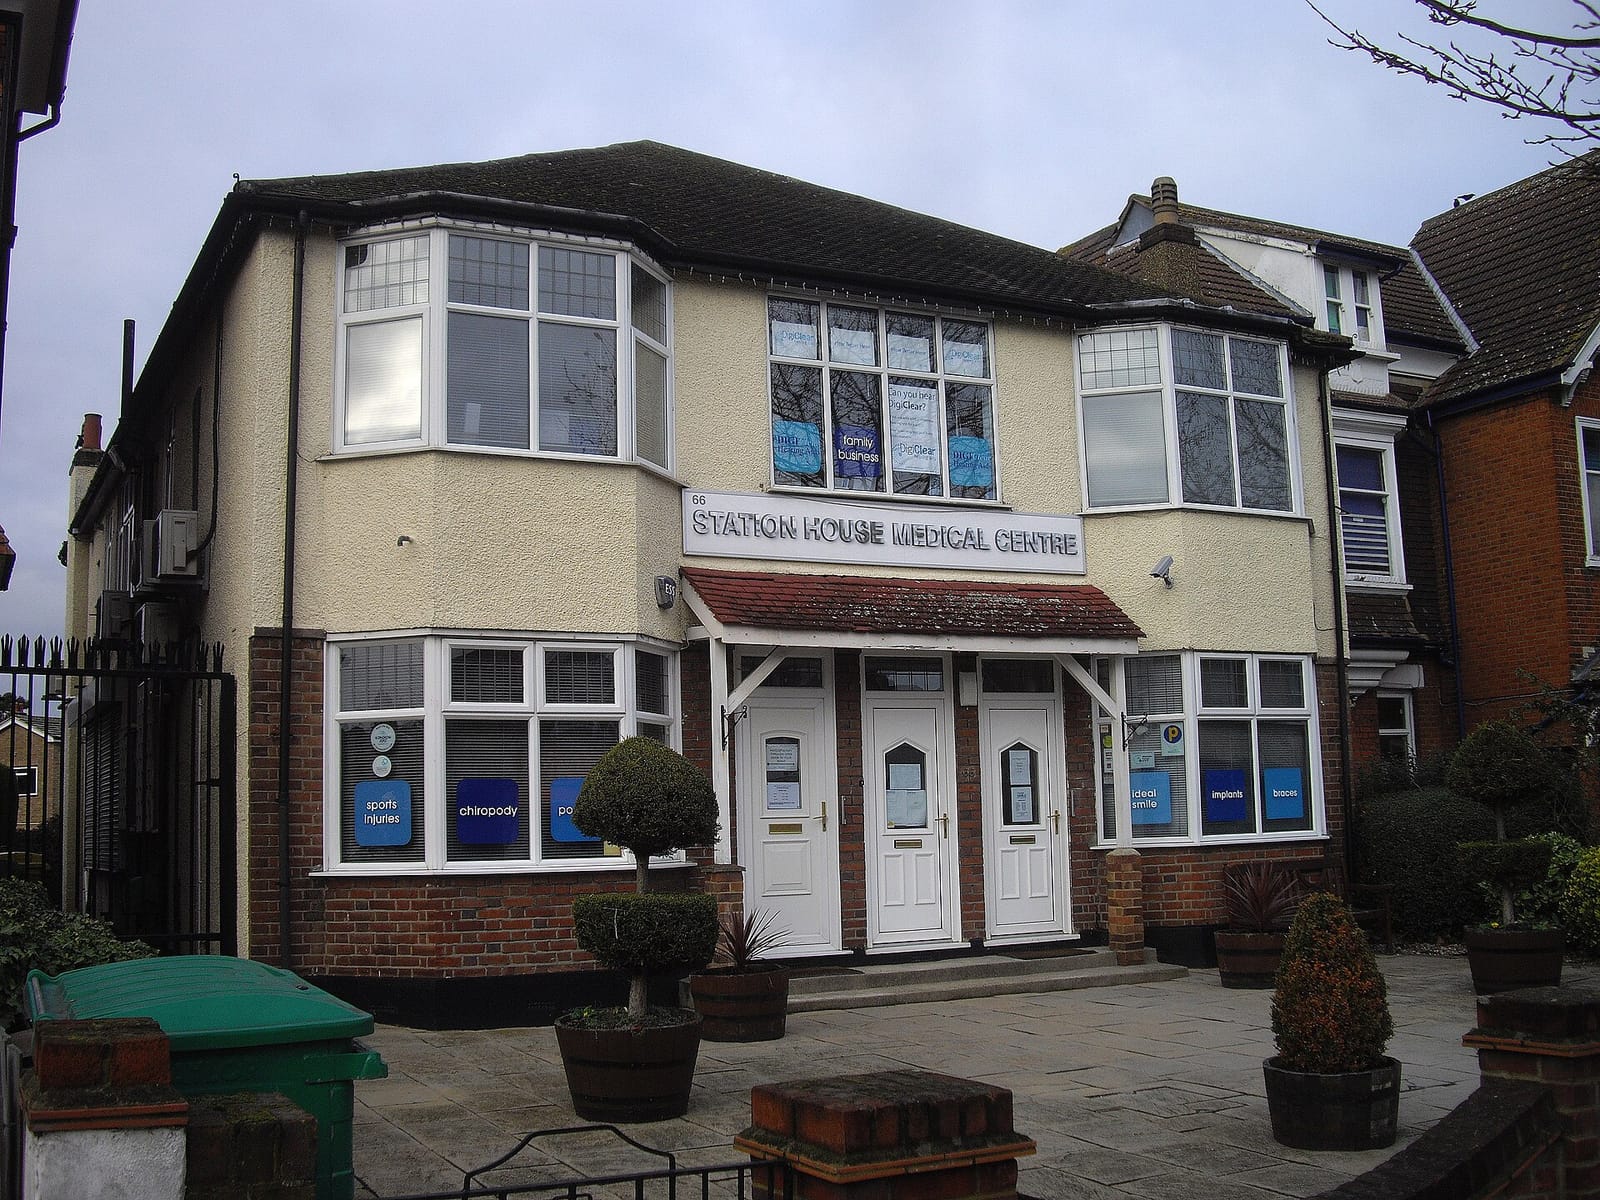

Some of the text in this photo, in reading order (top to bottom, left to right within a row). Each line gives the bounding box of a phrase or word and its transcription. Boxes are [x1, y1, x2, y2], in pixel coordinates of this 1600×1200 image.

[889, 387, 936, 401] Can you hear
[889, 400, 926, 411] DigiClear?
[842, 435, 874, 449] family
[899, 442, 936, 456] DigiClear
[838, 449, 879, 463] business
[692, 495, 706, 505] 66
[691, 509, 1079, 555] STATION HOUSE MEDICAL CENTRE
[1131, 789, 1157, 798] ideal
[1211, 790, 1244, 800] implants
[1272, 789, 1298, 798] braces
[366, 799, 397, 814] sports
[1131, 799, 1158, 809] smile
[459, 805, 519, 818] chiropody
[558, 805, 573, 817] po
[364, 813, 400, 827] injuries
